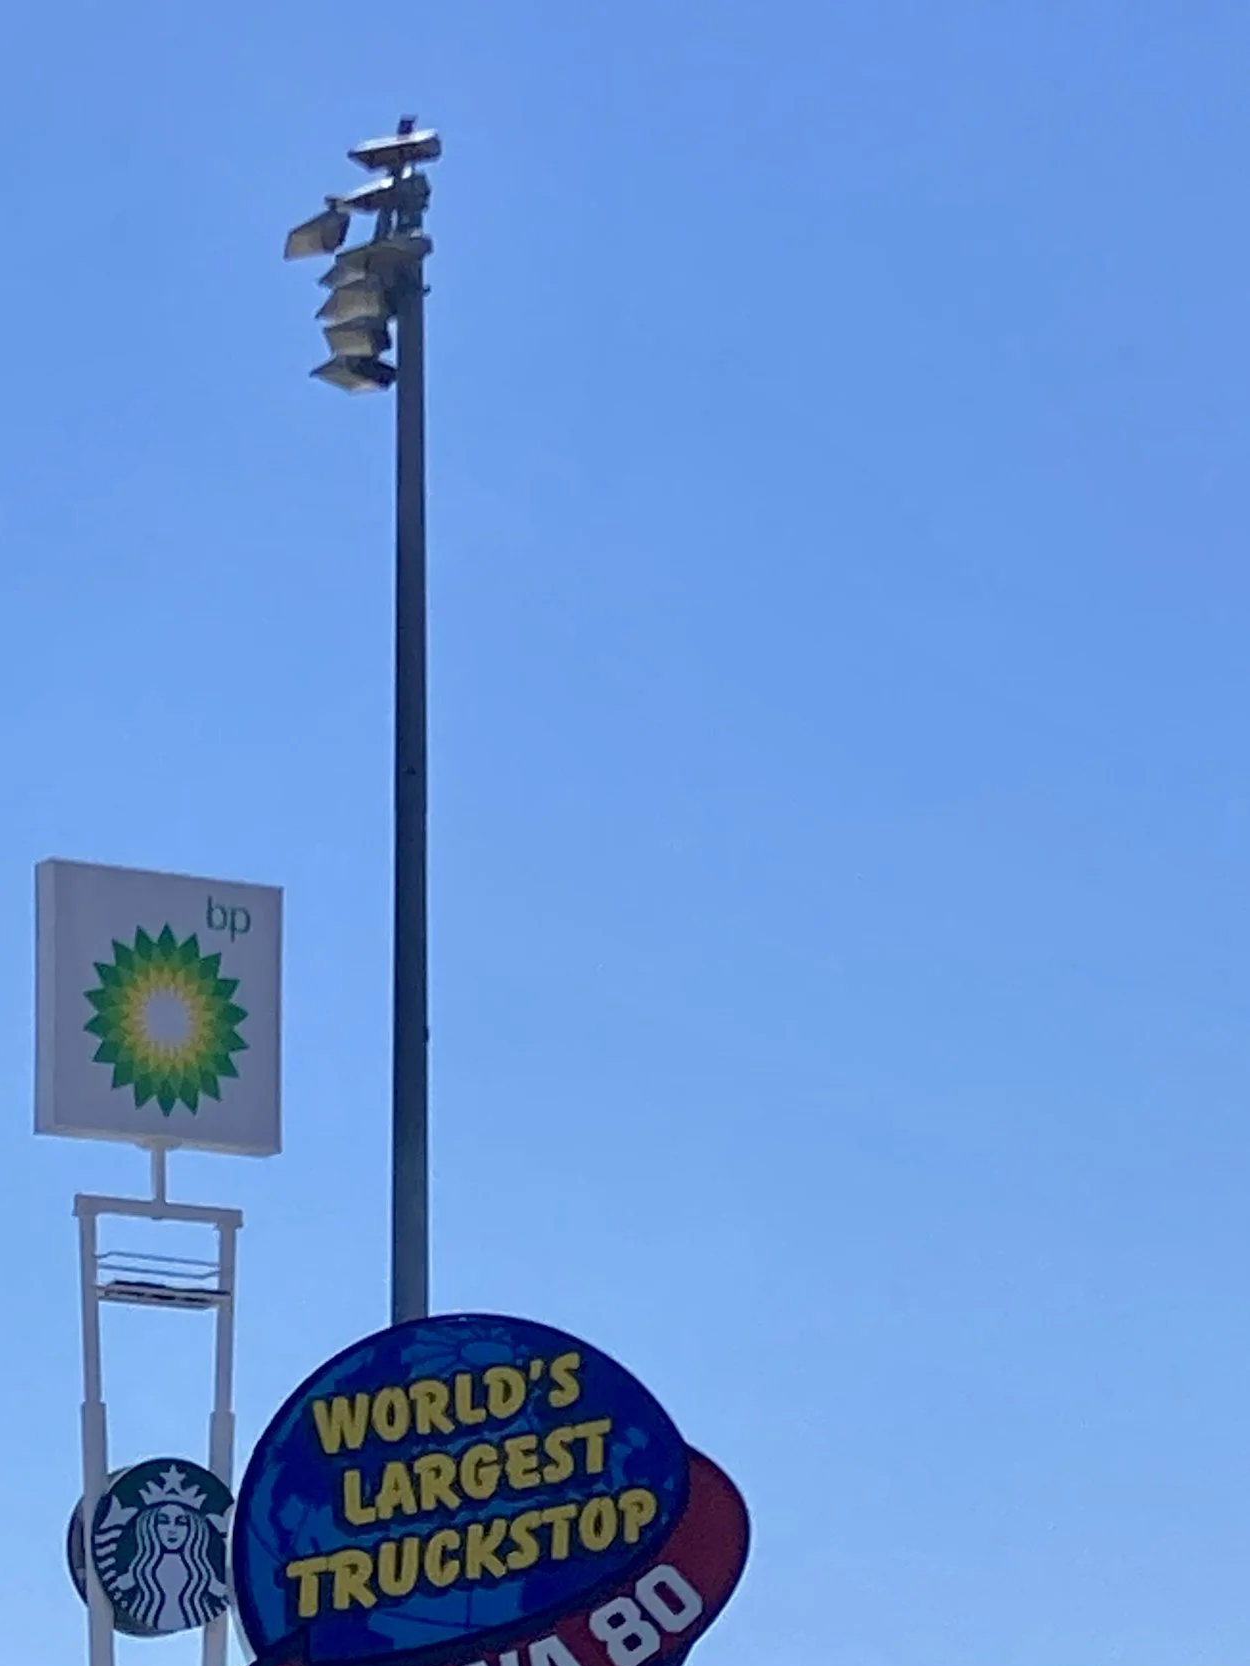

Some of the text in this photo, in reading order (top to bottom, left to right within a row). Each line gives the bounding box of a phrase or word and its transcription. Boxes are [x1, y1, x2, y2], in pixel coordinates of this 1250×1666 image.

[206, 896, 251, 942] bp
[312, 1352, 582, 1455] WORLD'S
[341, 1418, 612, 1525] LARGEST
[285, 1488, 658, 1618] TRUCKSTOP
